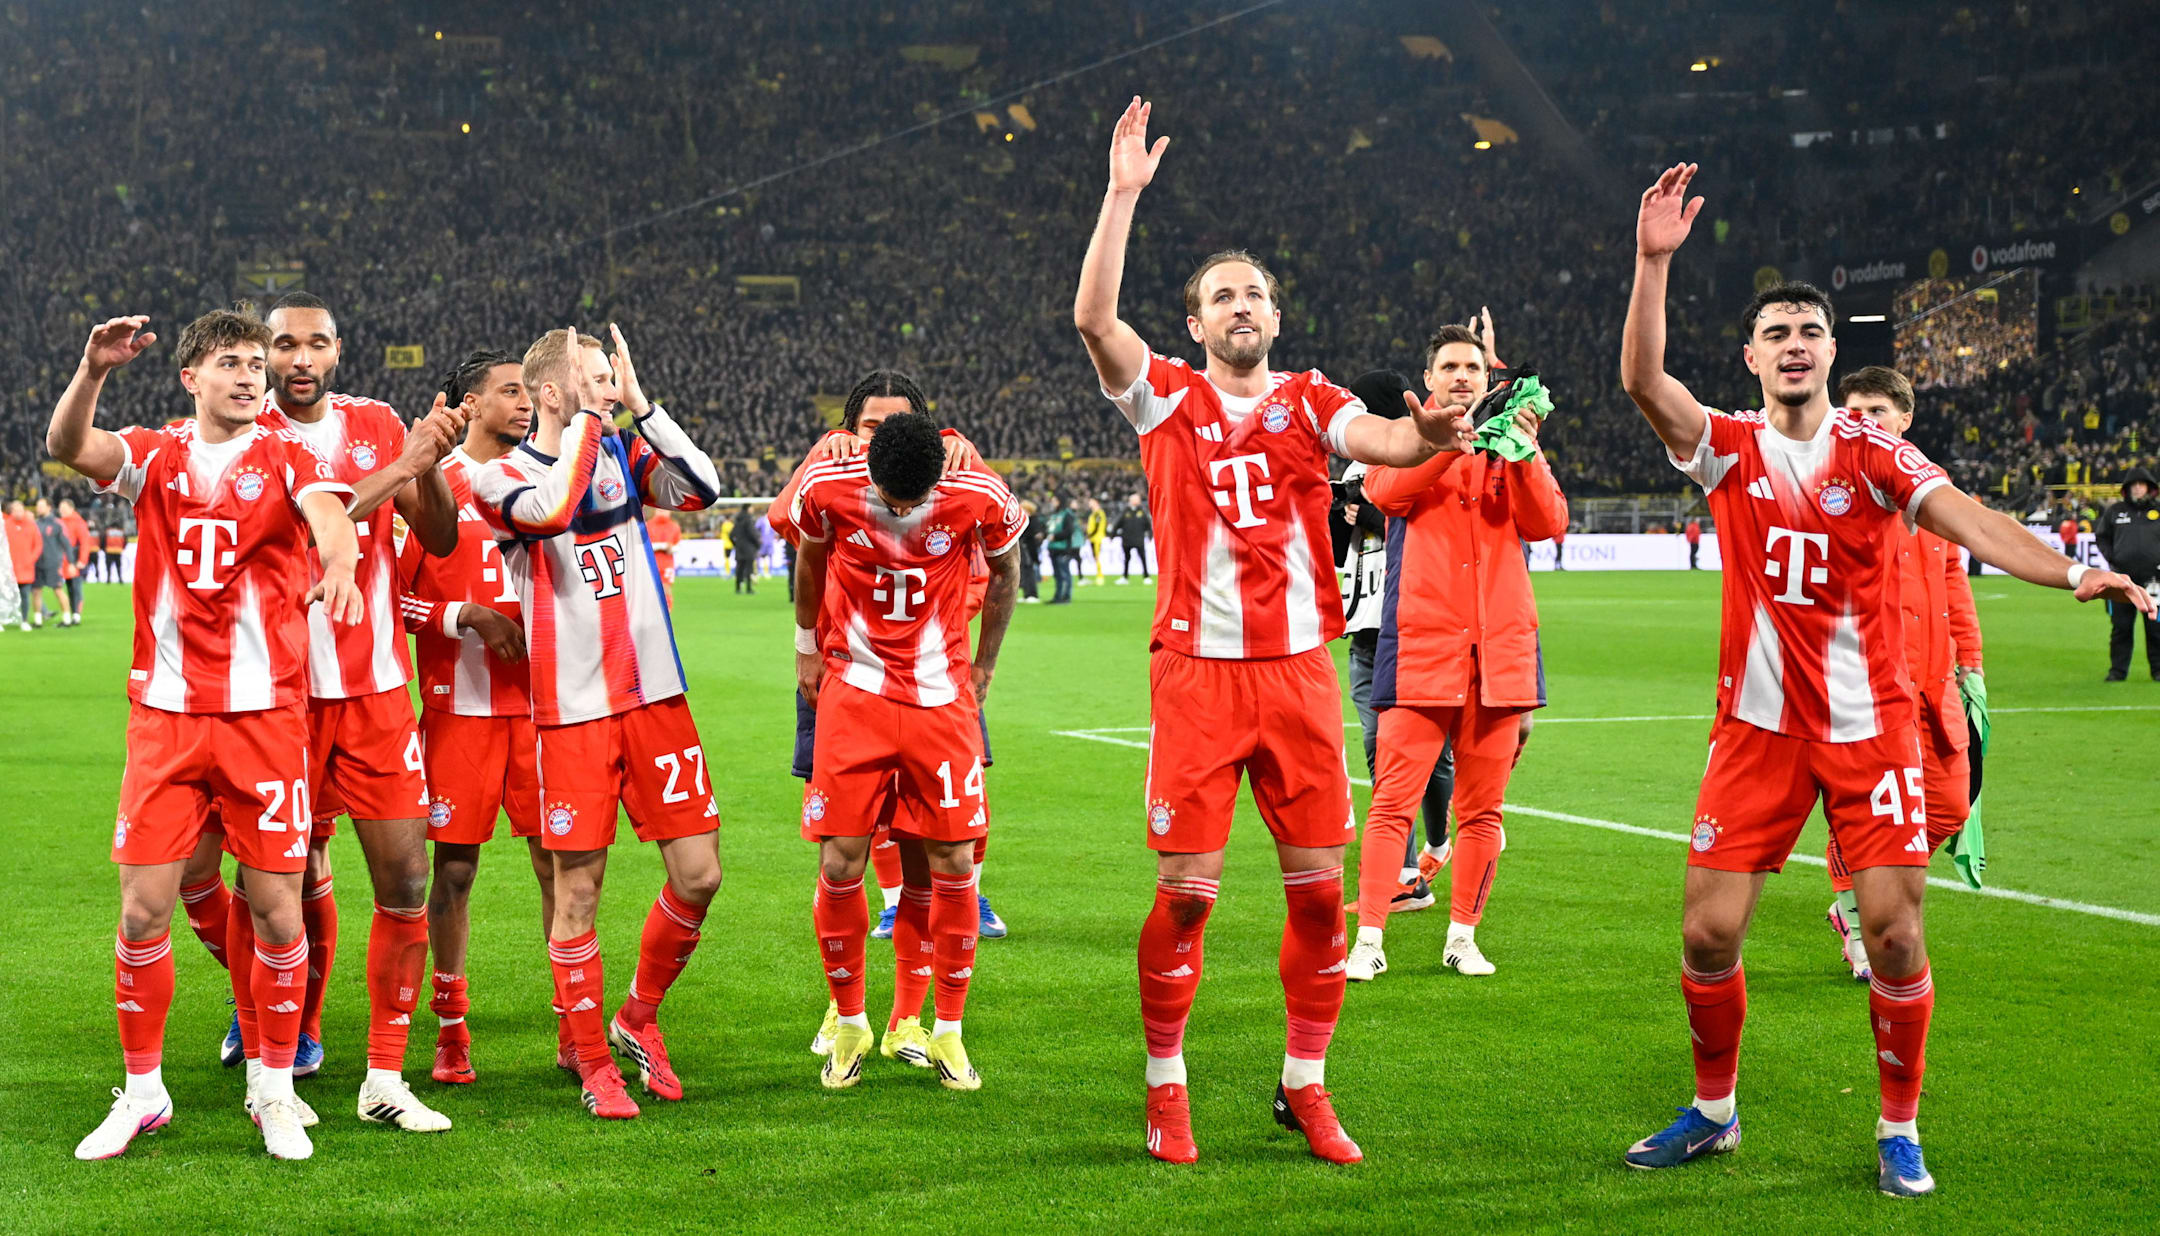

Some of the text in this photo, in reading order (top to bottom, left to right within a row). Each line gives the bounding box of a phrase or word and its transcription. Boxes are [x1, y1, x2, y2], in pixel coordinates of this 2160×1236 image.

[1849, 261, 1906, 283] vodafone
[1991, 239, 2056, 264] vodafone
[1209, 452, 1274, 529] T
[177, 517, 237, 590] T
[574, 534, 625, 600] T
[1764, 525, 1829, 606] T
[873, 565, 927, 621] T
[403, 731, 426, 780] 4
[655, 745, 706, 804] 27
[936, 755, 985, 808] 14
[256, 778, 310, 832] 20
[1870, 767, 1926, 825] 45
